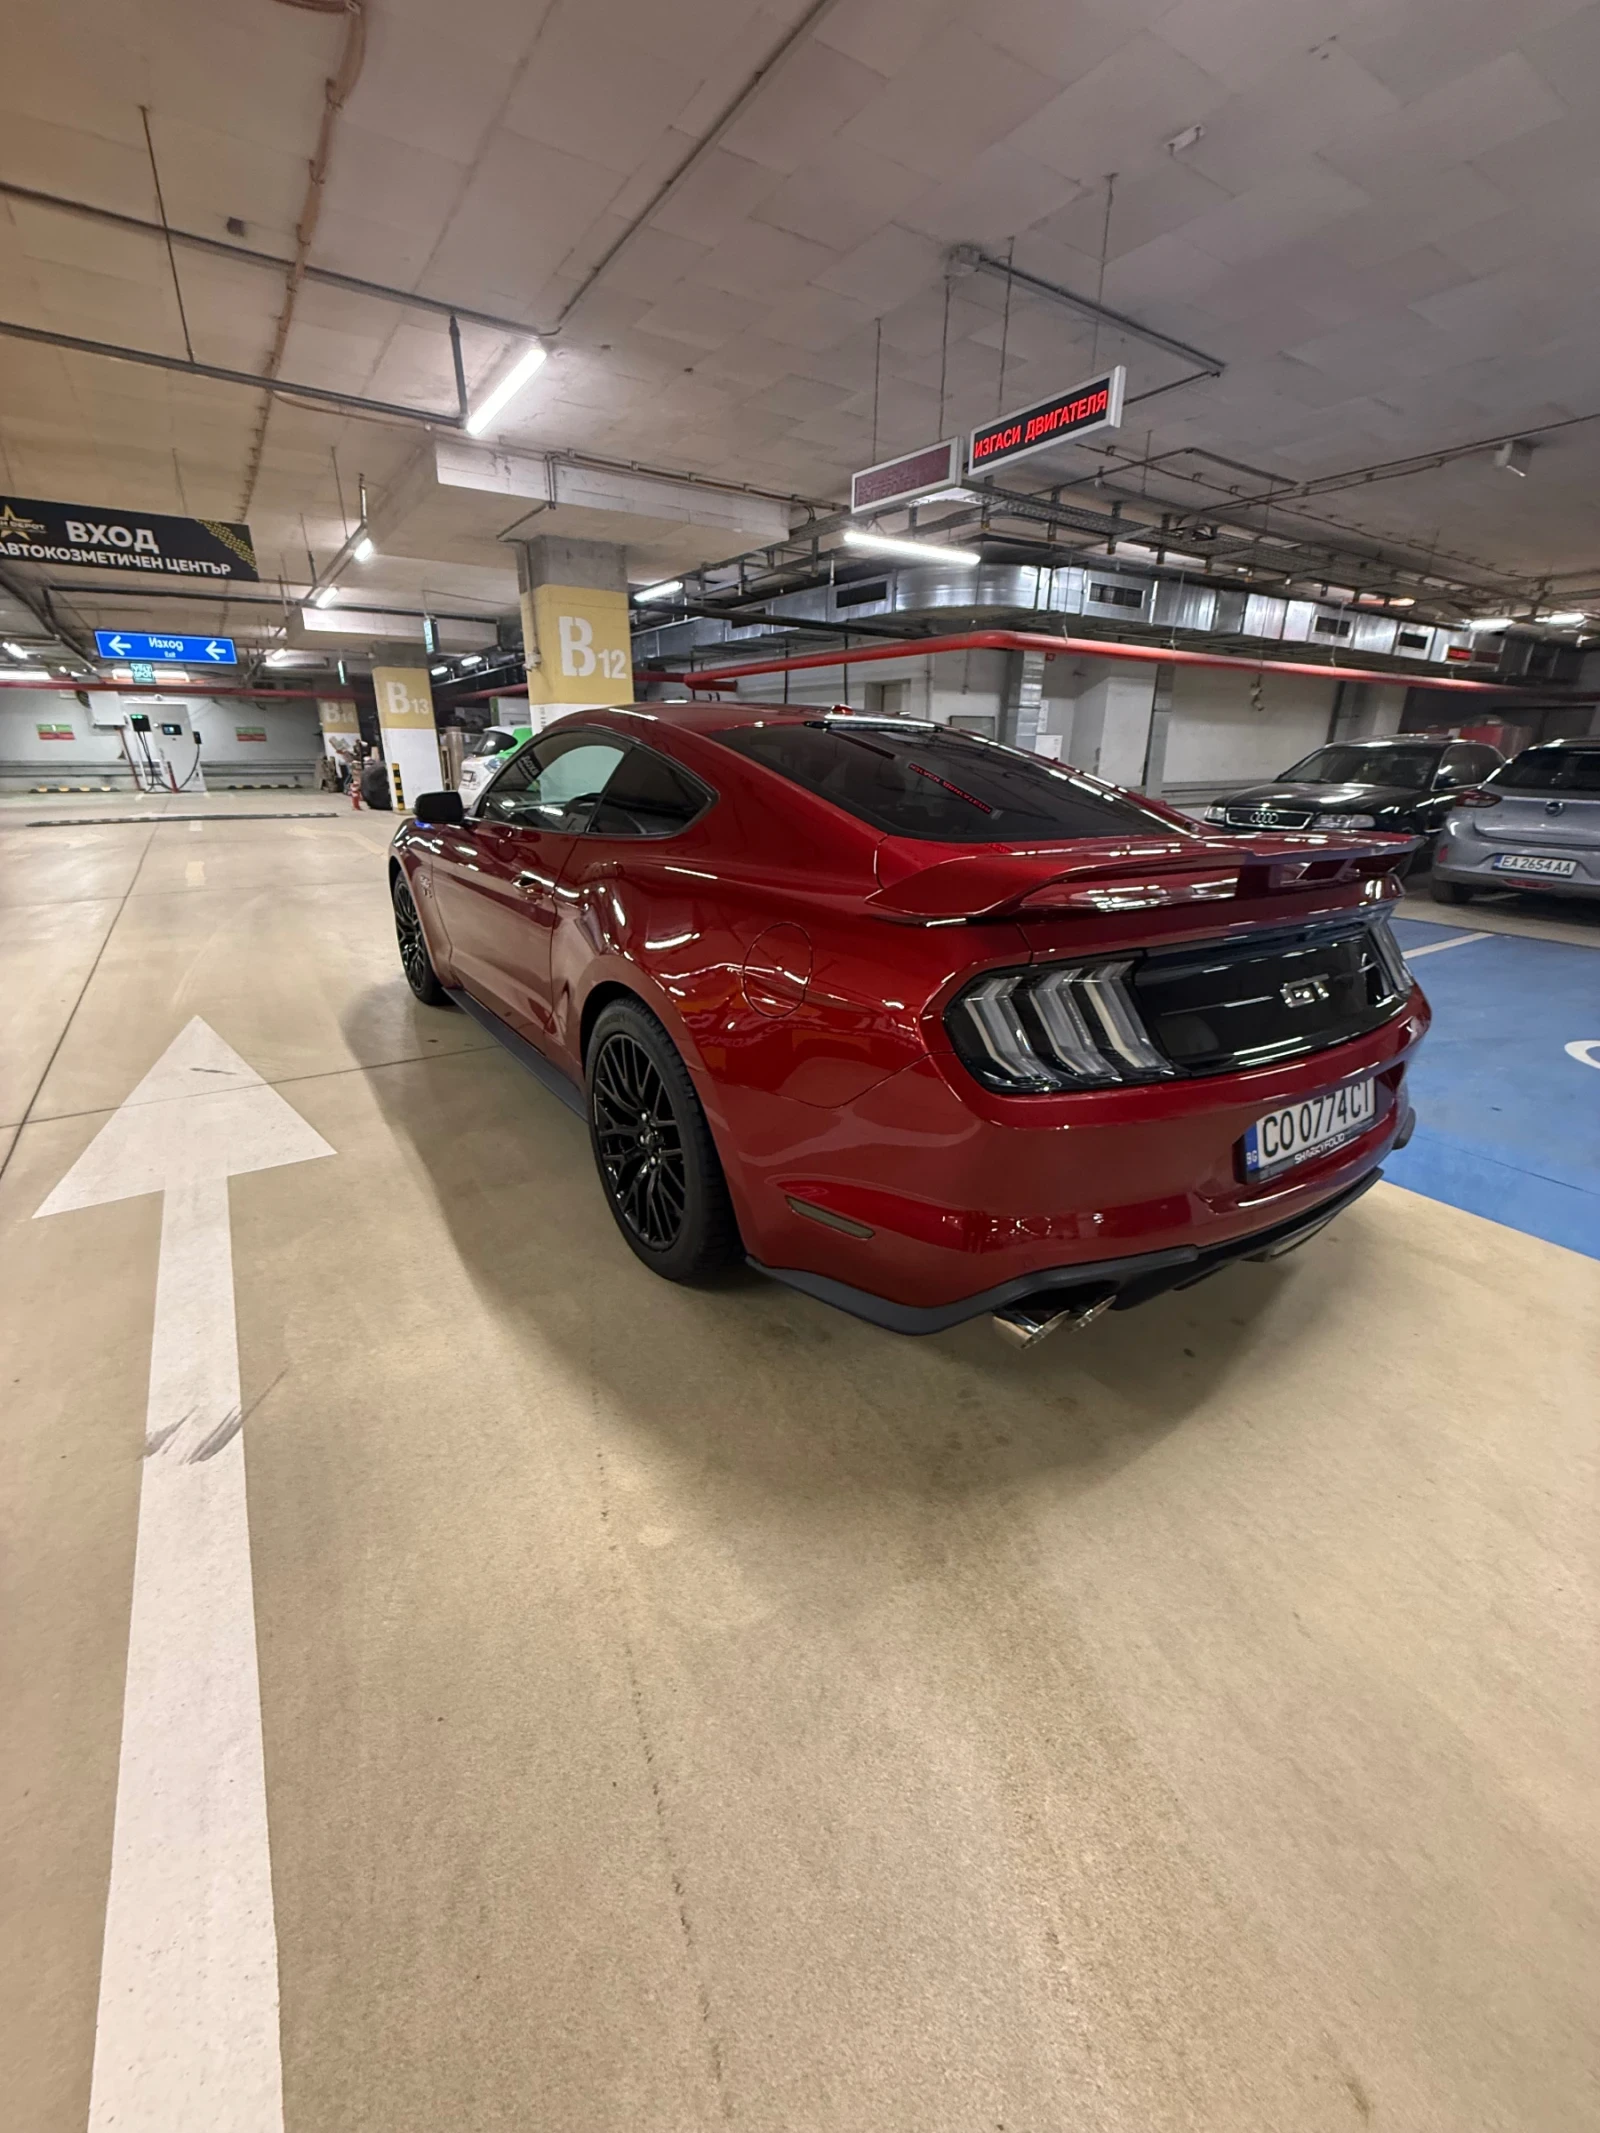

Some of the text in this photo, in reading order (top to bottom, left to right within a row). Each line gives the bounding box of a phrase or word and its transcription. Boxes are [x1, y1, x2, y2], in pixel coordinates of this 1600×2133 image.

[974, 390, 1107, 458] ИЗГАСИ ДВИГАТЕЛЯ
[65, 520, 160, 554] ВХОД
[0, 541, 231, 575] АВТОКОЗМЕТИЧЕН ЦЕНТЪР
[148, 636, 184, 652] Изход
[558, 615, 627, 679] B12
[385, 681, 430, 715] B13
[1502, 856, 1571, 873] EA 2654 AA
[1262, 1110, 1295, 1158] CO
[1299, 1088, 1347, 1142] 0774
[1246, 1150, 1258, 1165] BG
